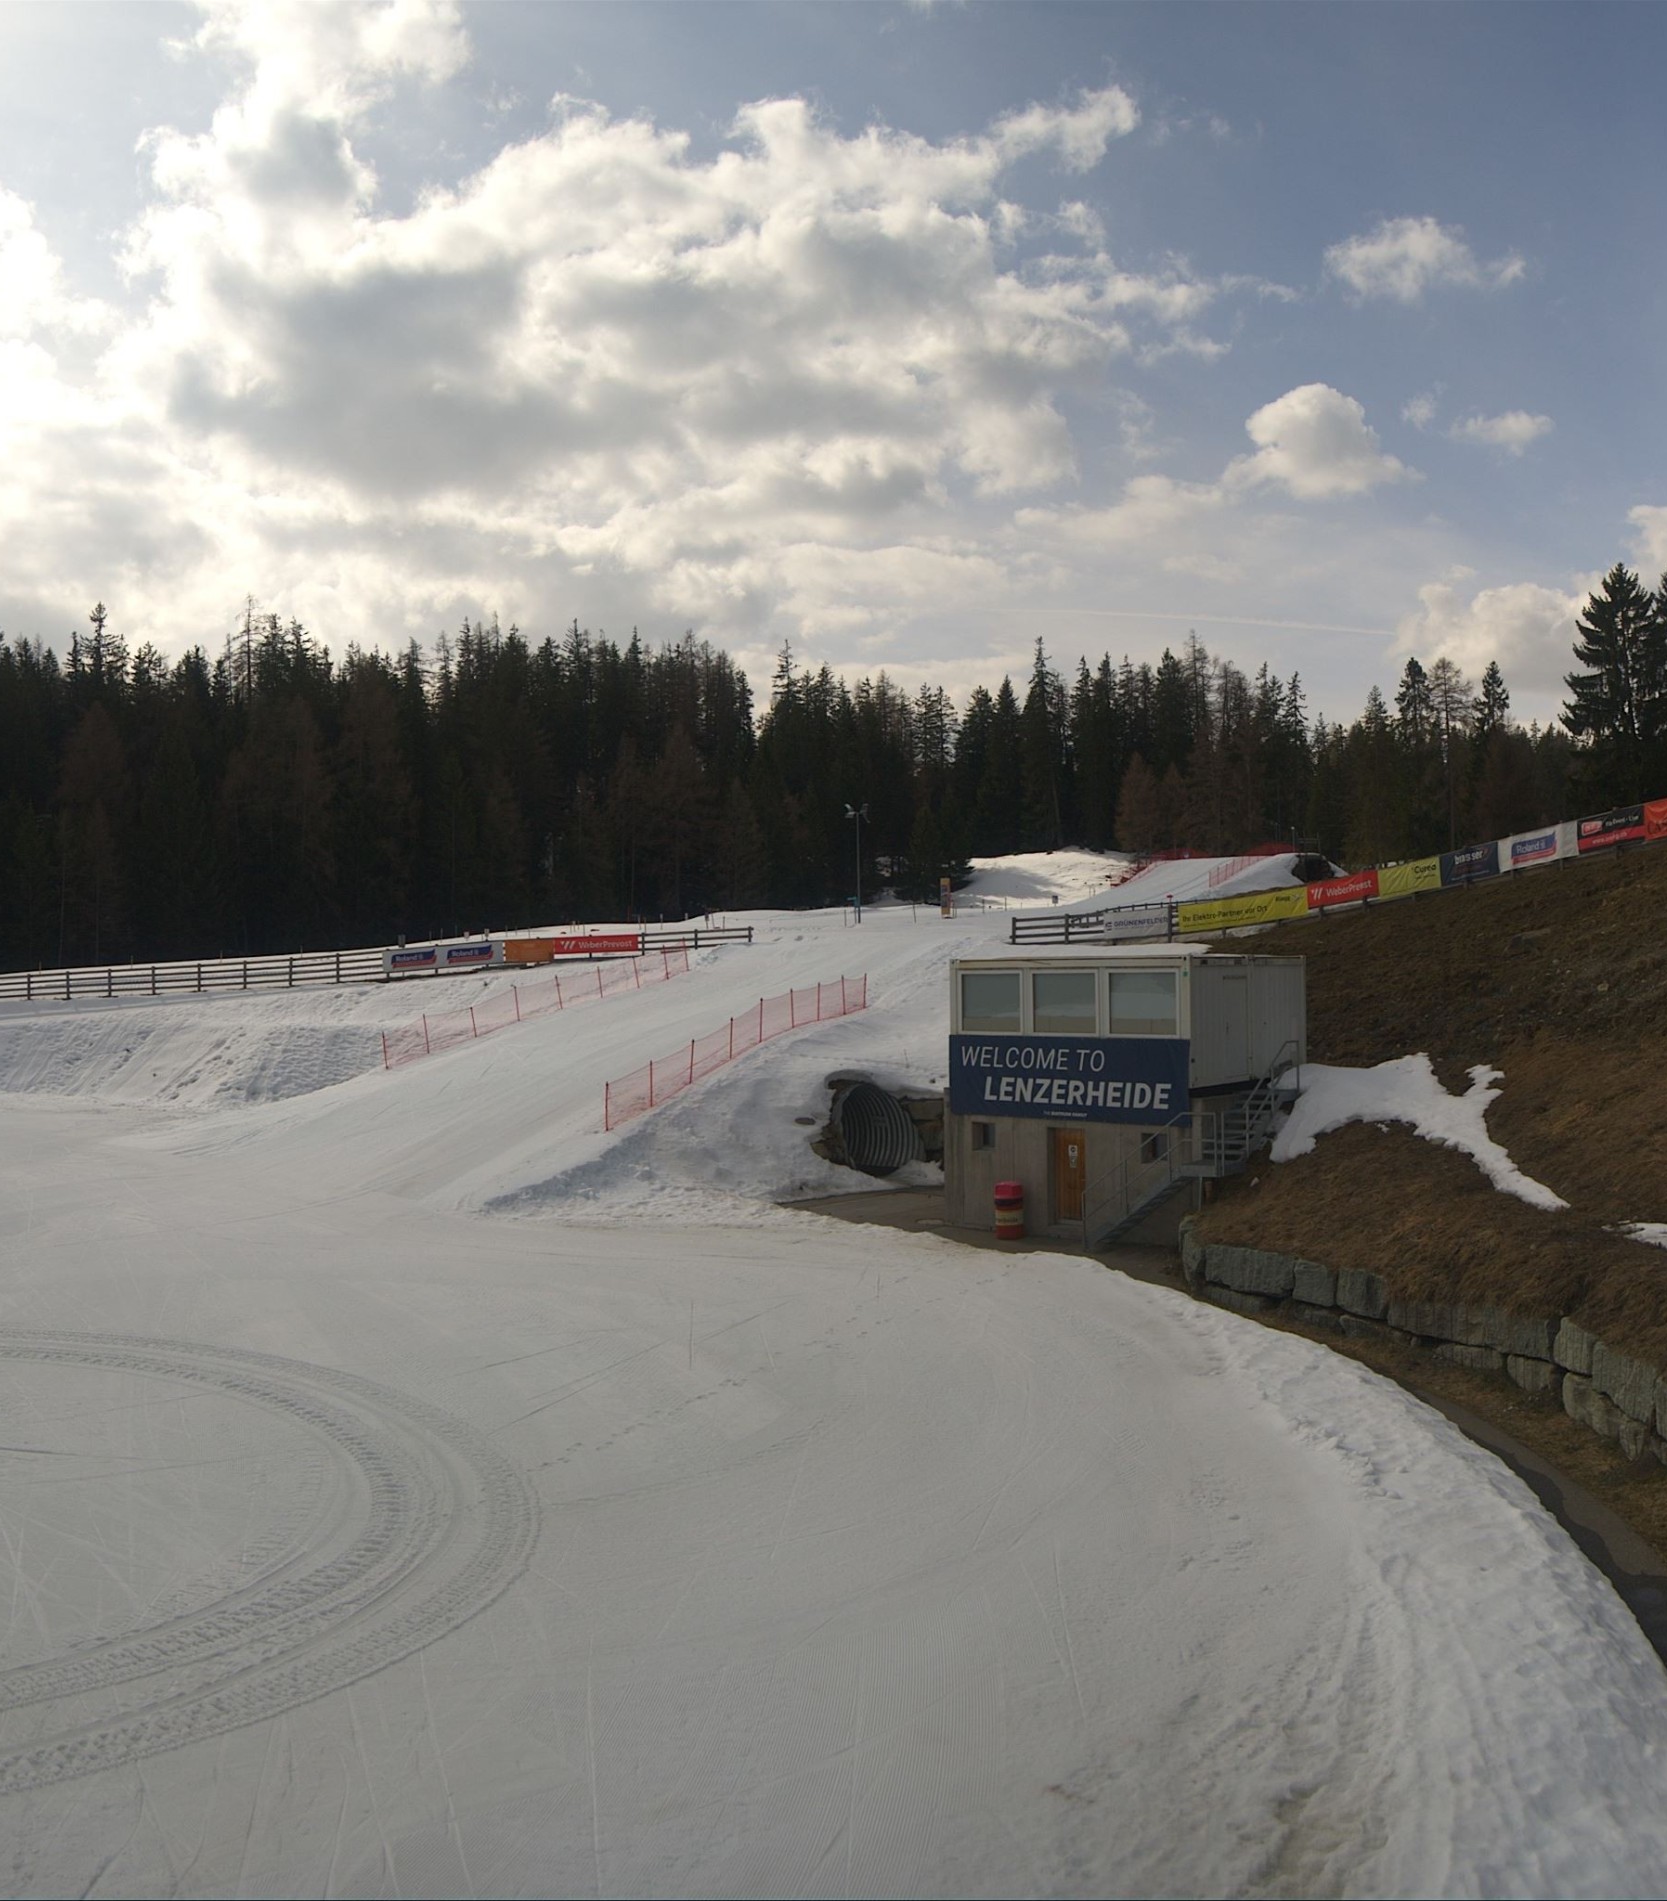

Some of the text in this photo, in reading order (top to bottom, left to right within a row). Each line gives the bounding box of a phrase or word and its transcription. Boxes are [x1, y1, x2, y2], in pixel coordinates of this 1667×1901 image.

[1515, 841, 1541, 854] Roland
[1192, 908, 1244, 922] Elektro-Partner
[578, 939, 633, 950] WeberPrevost
[960, 1046, 1105, 1072] WELCOME TO
[983, 1076, 1173, 1110] LENZERHEIDE
